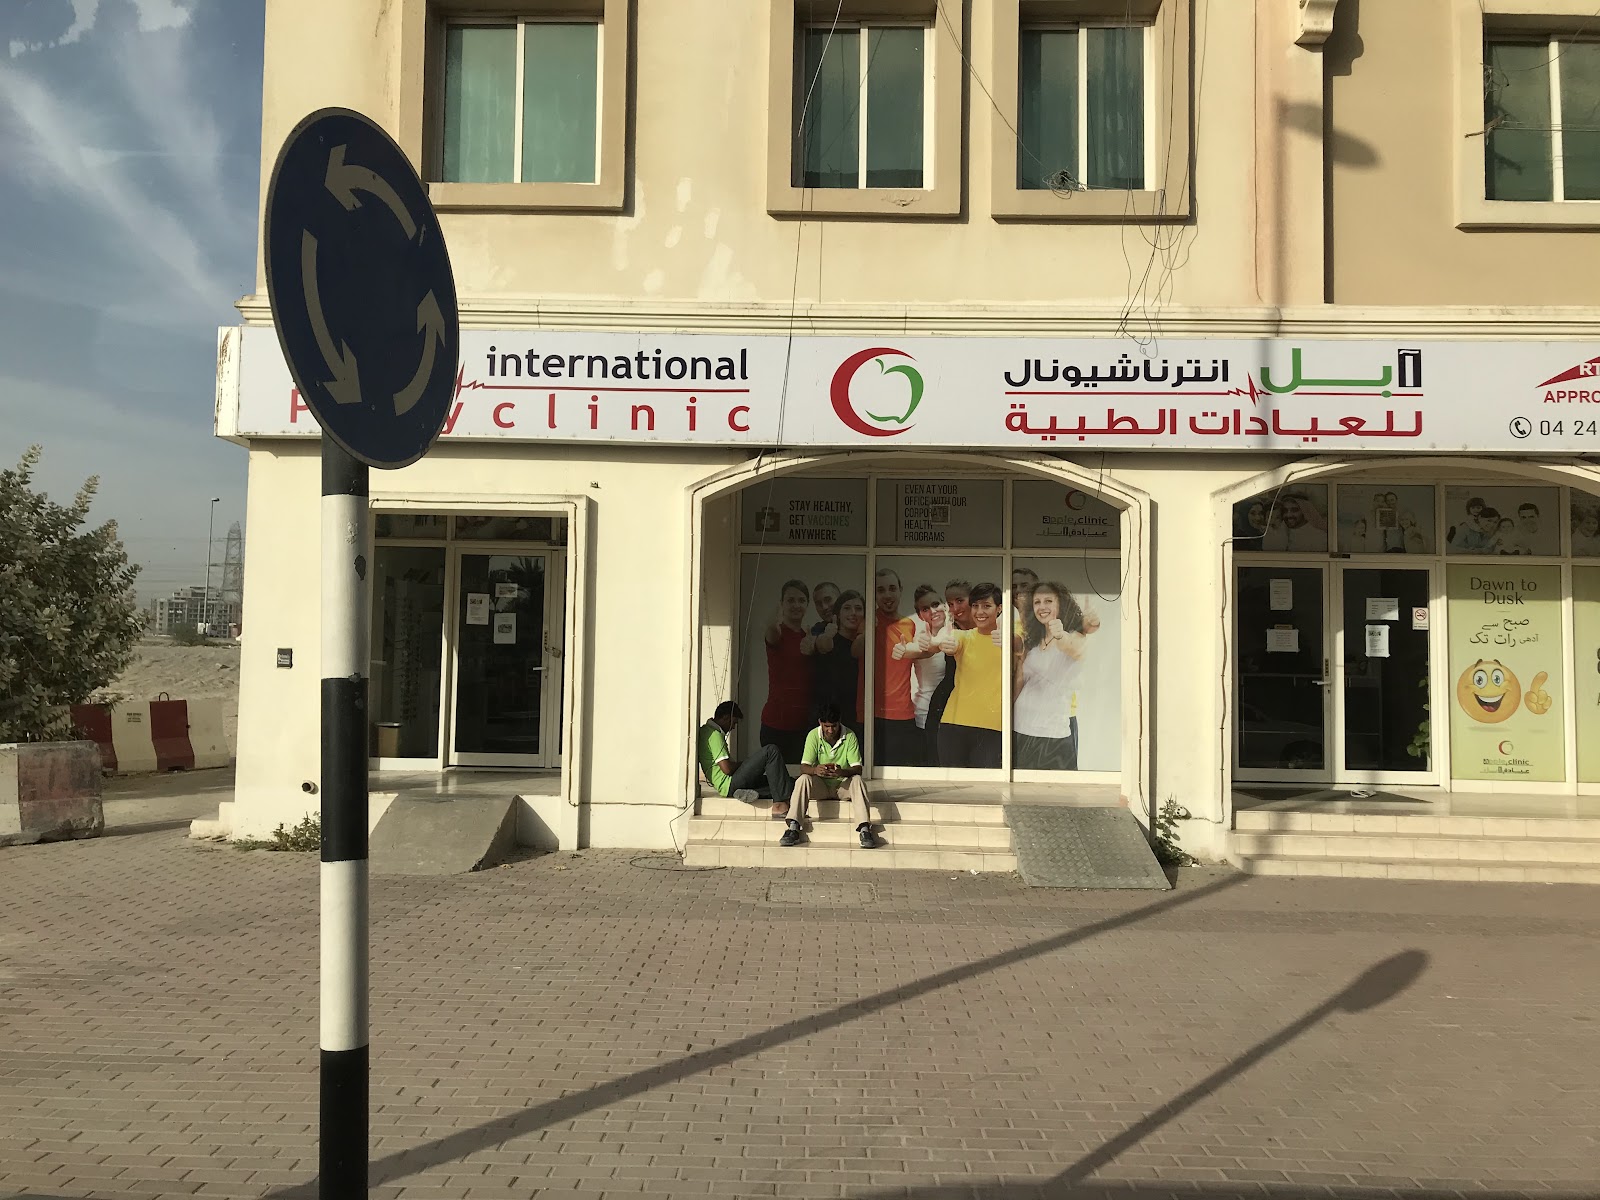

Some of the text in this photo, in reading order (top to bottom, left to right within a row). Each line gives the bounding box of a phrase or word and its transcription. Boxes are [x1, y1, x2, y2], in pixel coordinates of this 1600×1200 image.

[486, 346, 749, 381] international
[1004, 354, 1229, 388] انترناشيونال
[290, 388, 751, 434] Pyclinic
[1005, 404, 1423, 442] للعيادات الطبية
[1540, 420, 1597, 436] 04 24
[904, 484, 958, 495] EVEN AT YOUR
[789, 500, 853, 514] STAY HEALTHY,
[904, 496, 967, 506] OFFICE WITH OUR
[789, 514, 850, 527] GET VACCINES
[904, 519, 933, 529] HEALTH
[1077, 515, 1108, 525] clinic
[789, 528, 837, 541] ANYWHERE
[904, 531, 945, 542] PROGRAMS
[1470, 576, 1537, 591] Dawn to
[1484, 591, 1524, 605] Dusk
[1503, 618, 1530, 631] صبح
[1494, 633, 1516, 647] رات
